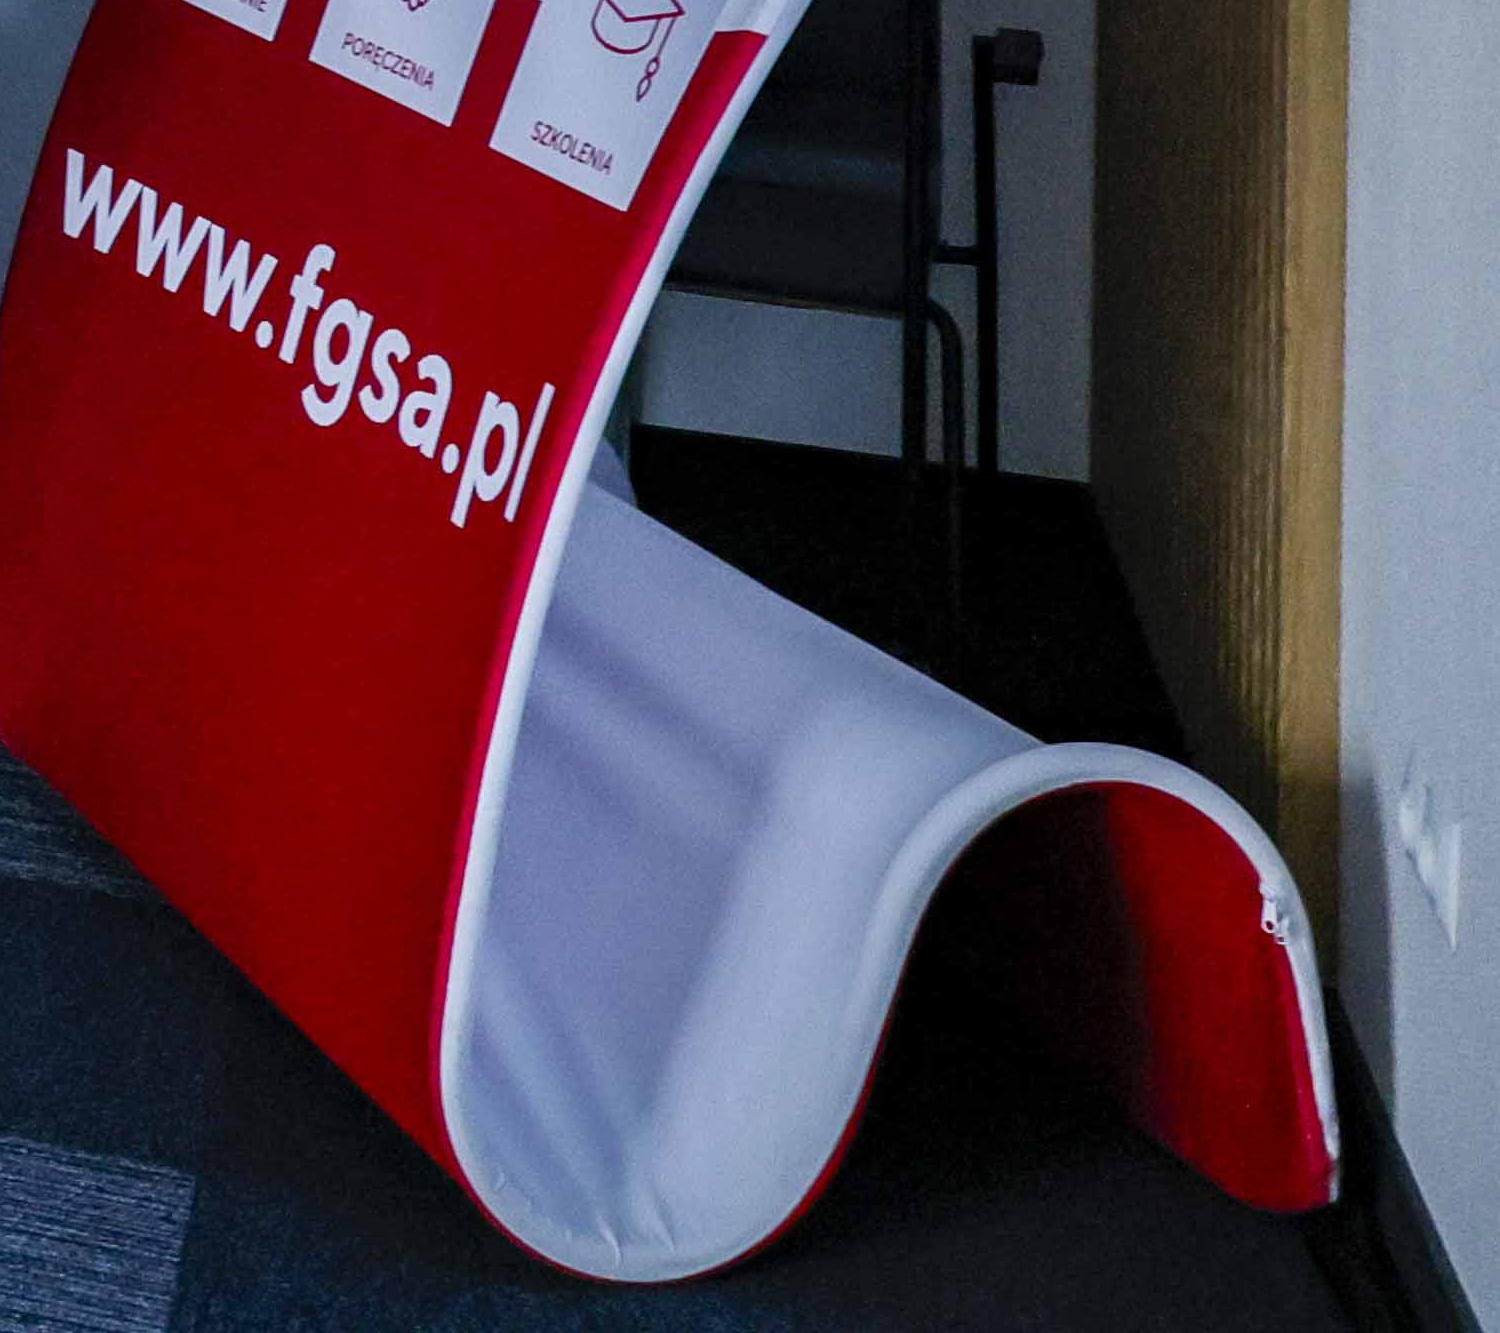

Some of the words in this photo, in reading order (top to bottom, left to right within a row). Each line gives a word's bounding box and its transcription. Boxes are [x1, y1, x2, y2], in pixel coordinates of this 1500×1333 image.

[342, 32, 435, 91] PORĘCZENIA
[530, 121, 613, 175] SZKOLENIA
[63, 147, 555, 529] www.fgsa.pl
